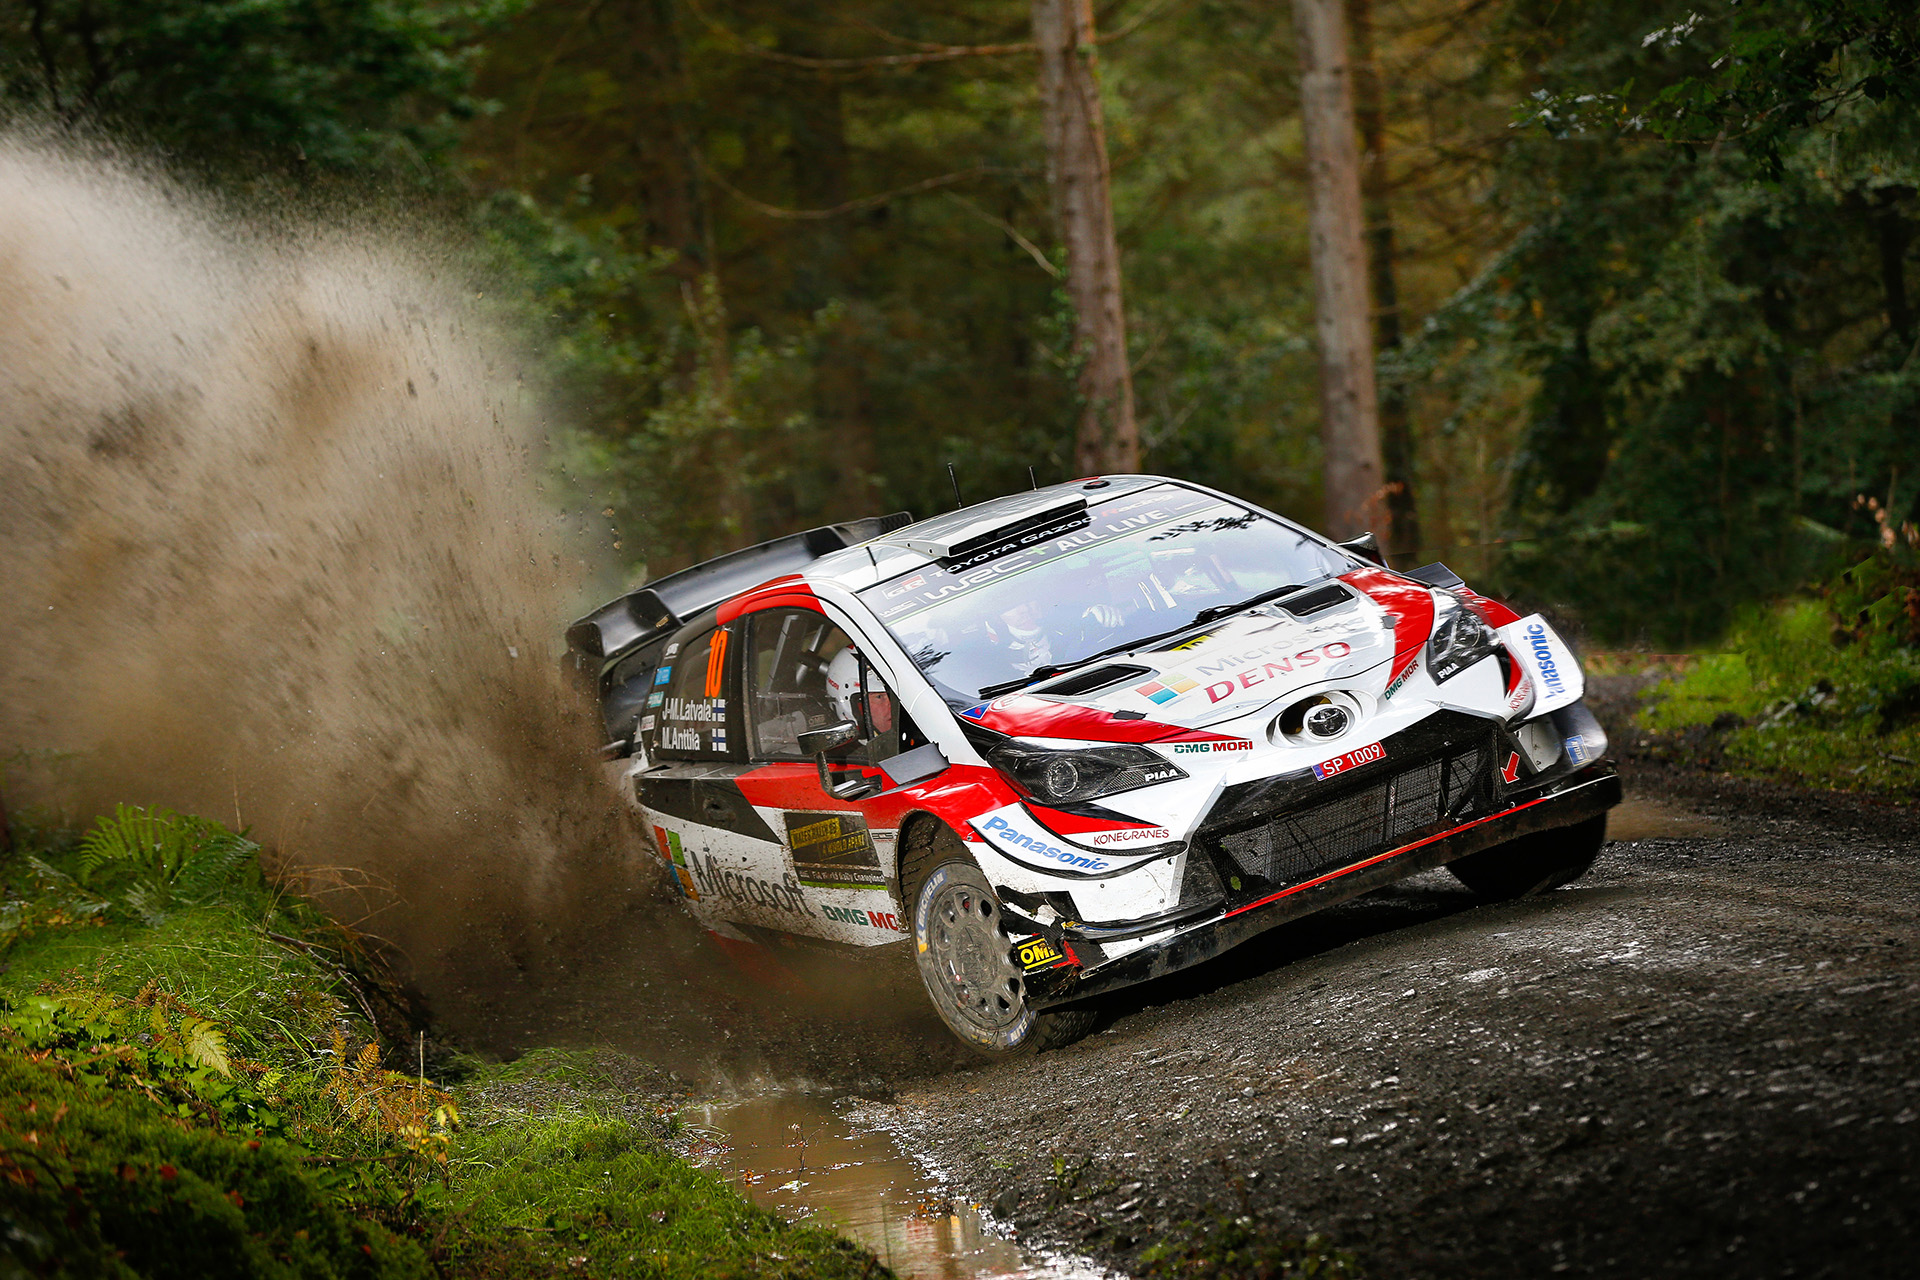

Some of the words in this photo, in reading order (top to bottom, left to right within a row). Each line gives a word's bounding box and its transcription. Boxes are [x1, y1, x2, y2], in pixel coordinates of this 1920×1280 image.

[929, 542, 1018, 577] TOYOTA
[1020, 514, 1098, 545] GAZOO
[1056, 529, 1109, 552] ALL
[1106, 509, 1169, 533] LIVE
[705, 630, 728, 698] 10
[1205, 641, 1351, 704] DENSO
[1437, 662, 1460, 679] PIAA
[1384, 677, 1403, 700] DMG
[1174, 743, 1211, 754] DMG
[1213, 740, 1253, 752] MORI
[1323, 758, 1344, 775] SP
[1346, 744, 1380, 766] 1009
[1144, 768, 1179, 783] PIAA
[983, 815, 1109, 871] Panasonic
[1094, 829, 1170, 846] KONECRANES
[690, 850, 817, 919] Microsoft
[917, 870, 945, 929] MICHELIN
[821, 904, 869, 926] DMG
[866, 910, 899, 931] MO
